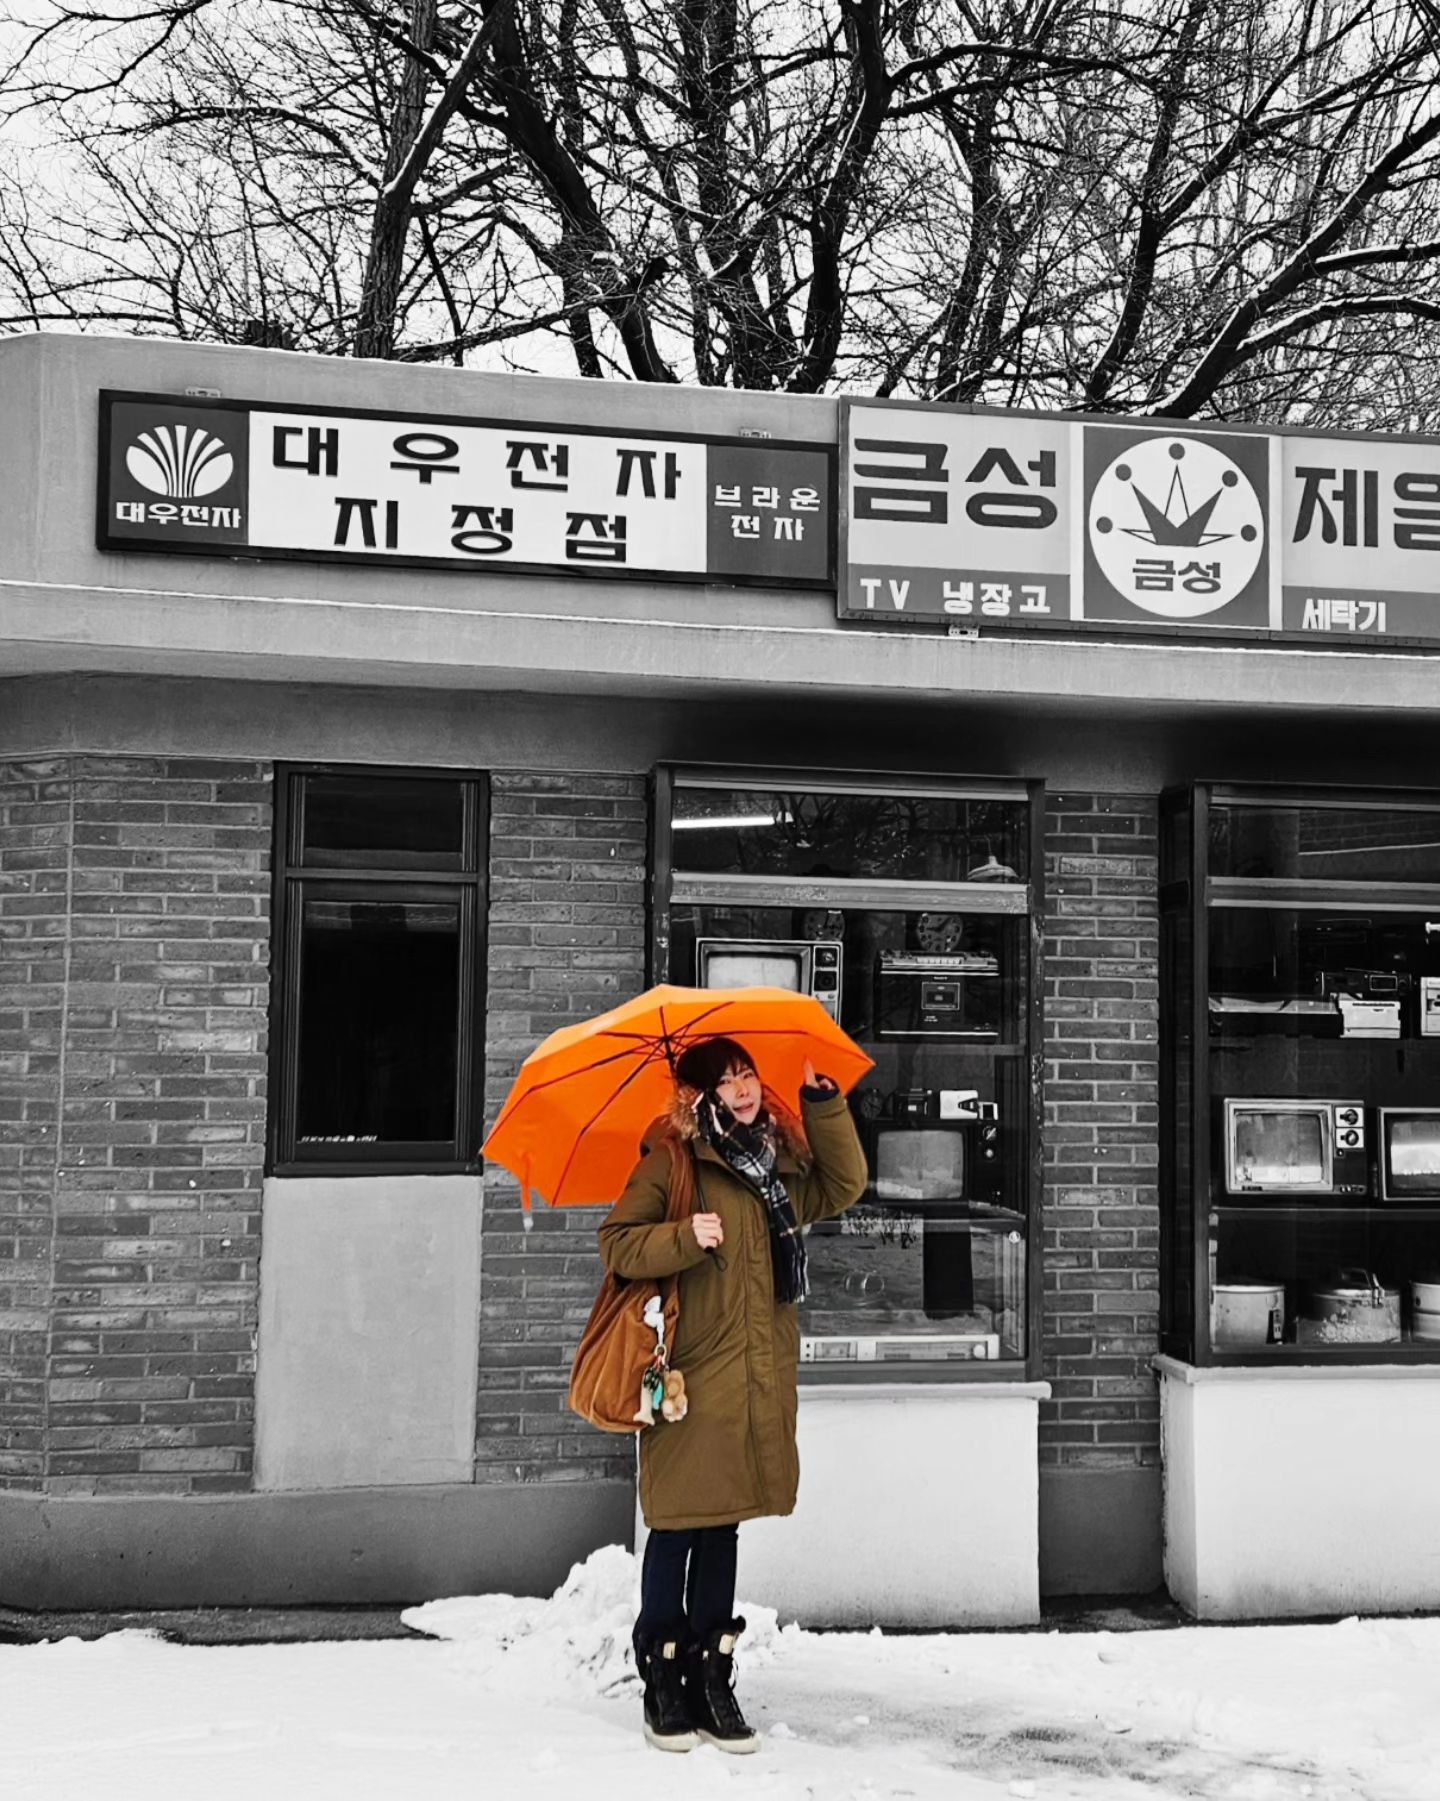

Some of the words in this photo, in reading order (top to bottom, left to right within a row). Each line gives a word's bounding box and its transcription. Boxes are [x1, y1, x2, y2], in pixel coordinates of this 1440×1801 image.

[272, 426, 682, 499] 대우전자
[714, 485, 820, 511] 브라운
[853, 438, 1058, 529] 금성
[115, 501, 242, 528] 대우전자
[334, 497, 626, 562] 지정점
[731, 515, 804, 541] 전자
[1132, 559, 1222, 594] 금성
[860, 578, 910, 610] TV
[943, 581, 1051, 616] 냉장고
[1302, 598, 1386, 632] 세탁기
